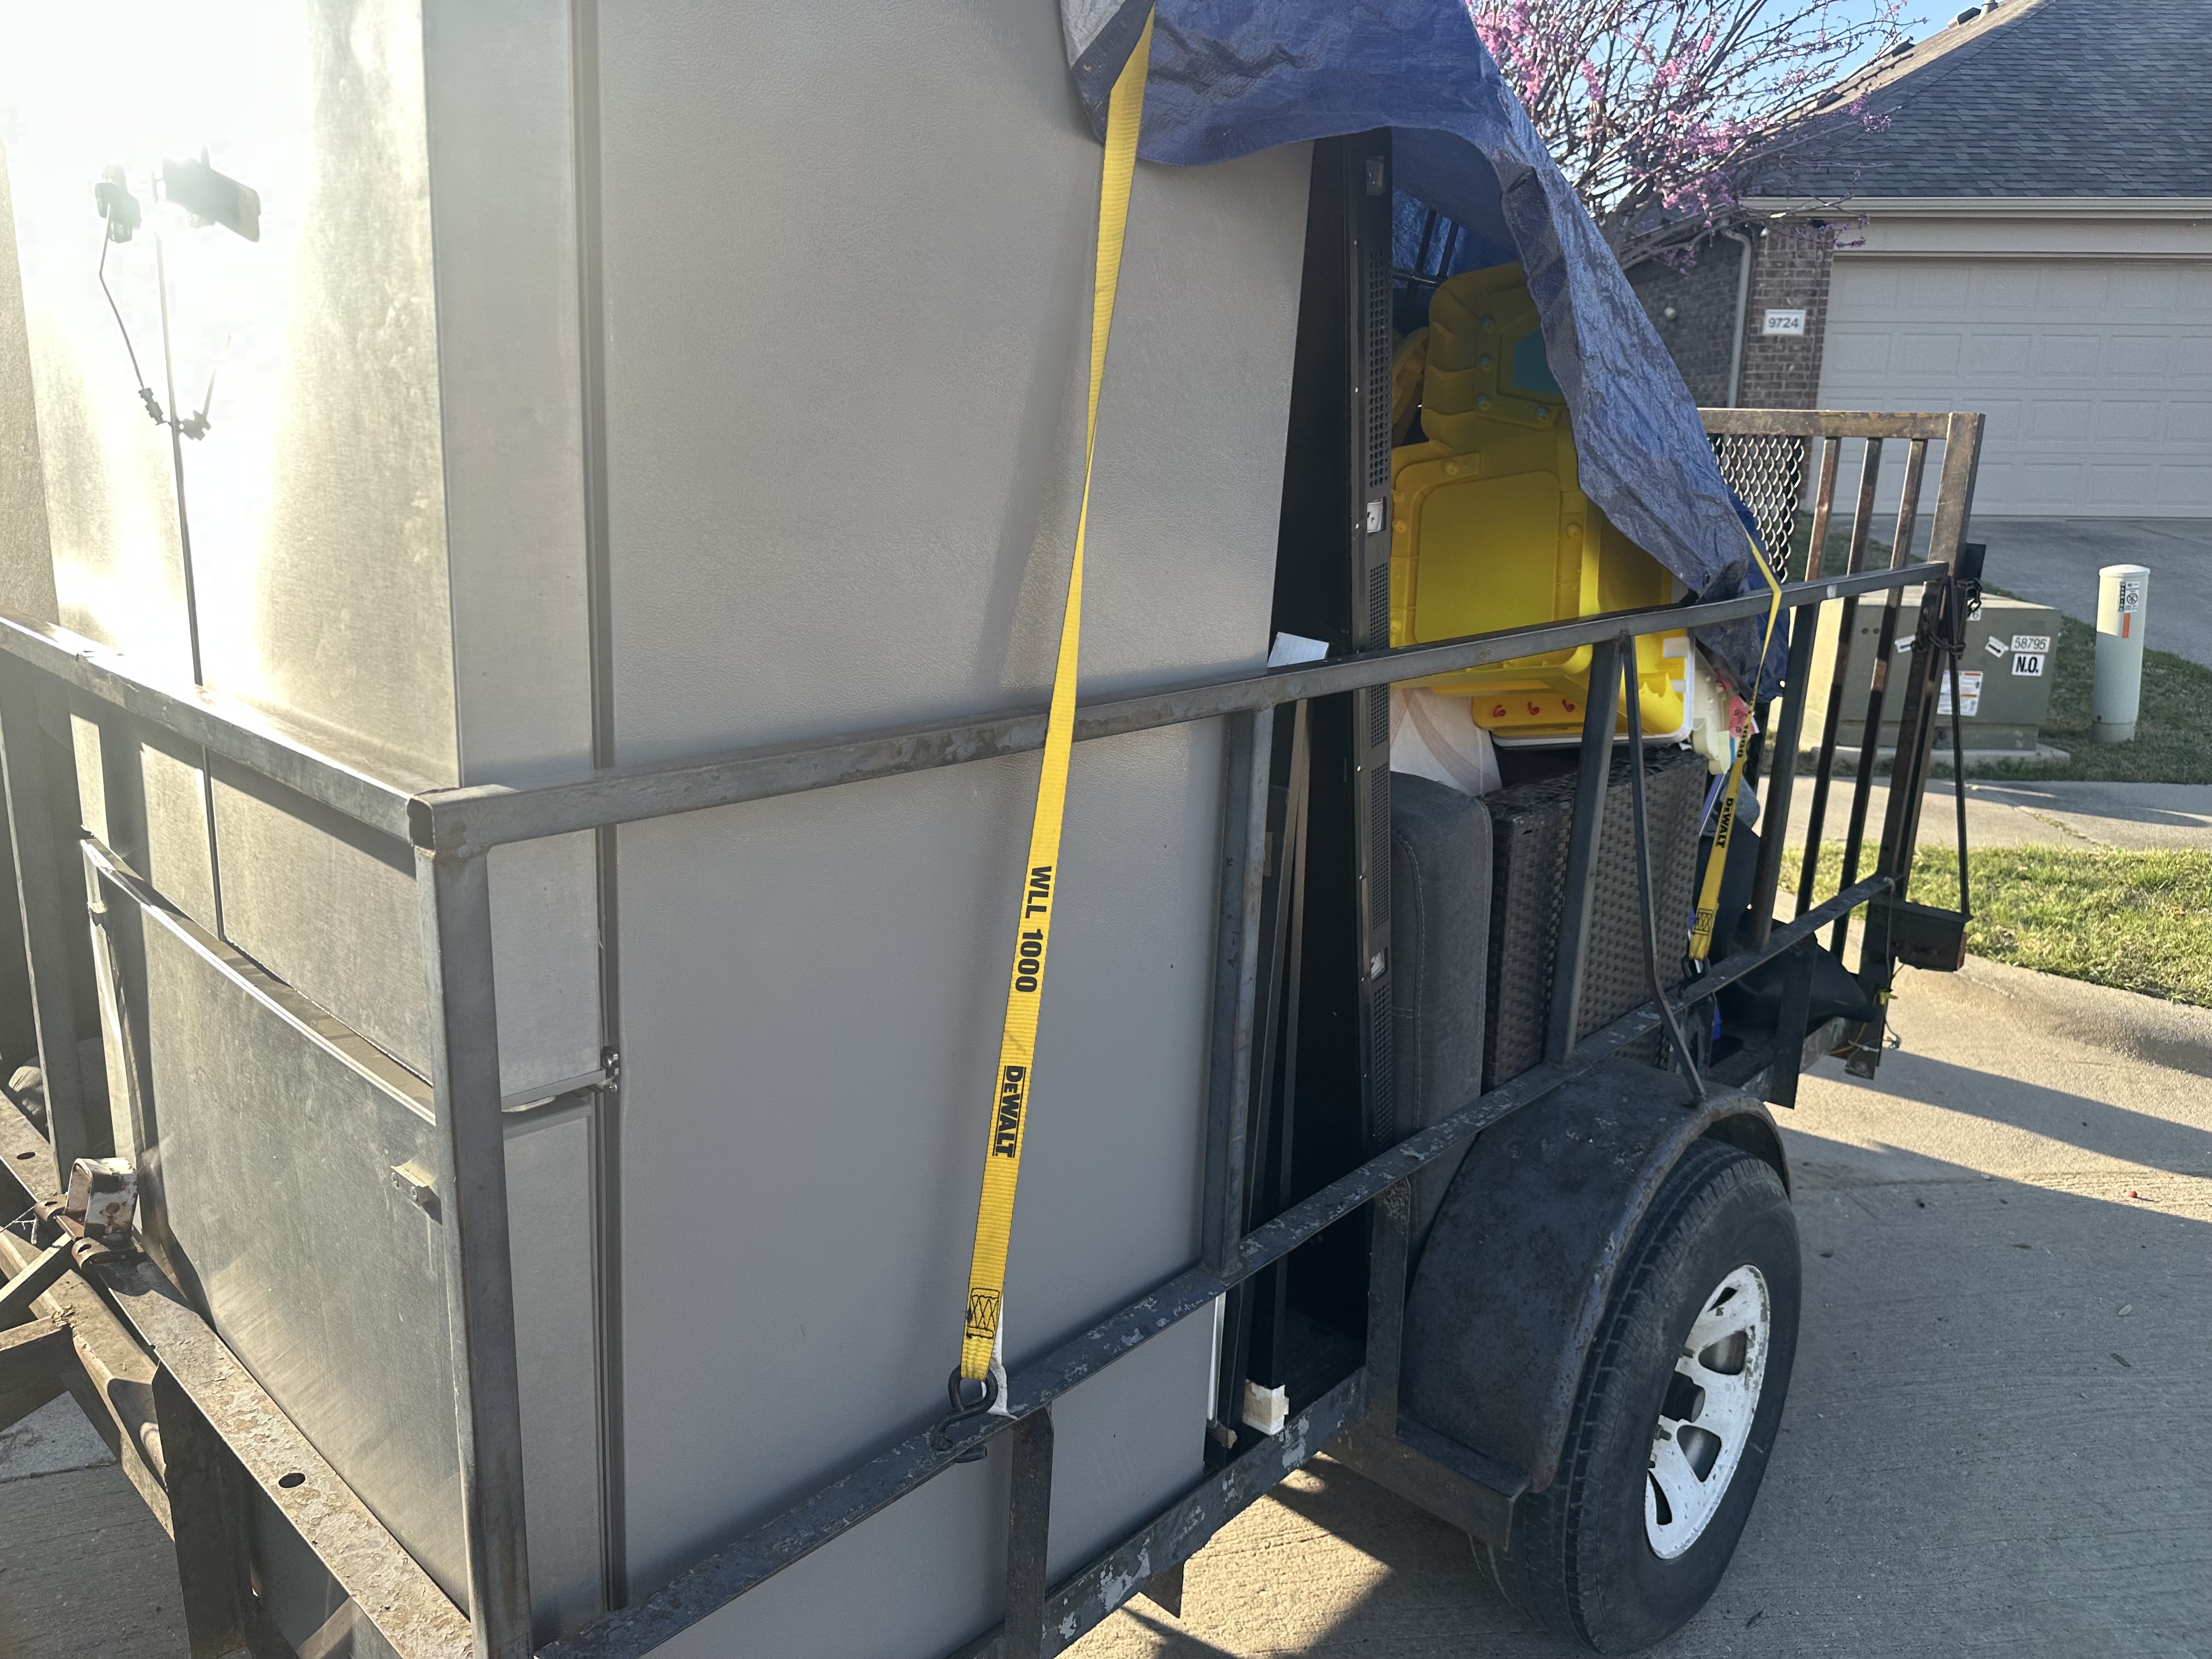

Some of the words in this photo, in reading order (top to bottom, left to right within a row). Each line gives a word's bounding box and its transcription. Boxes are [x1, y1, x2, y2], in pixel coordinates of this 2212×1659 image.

[1768, 317, 1798, 328] 9724
[2014, 637, 2047, 650] 58795
[2016, 656, 2039, 673] N.O.
[1025, 866, 1052, 919] WLL
[1015, 928, 1043, 992] 1000
